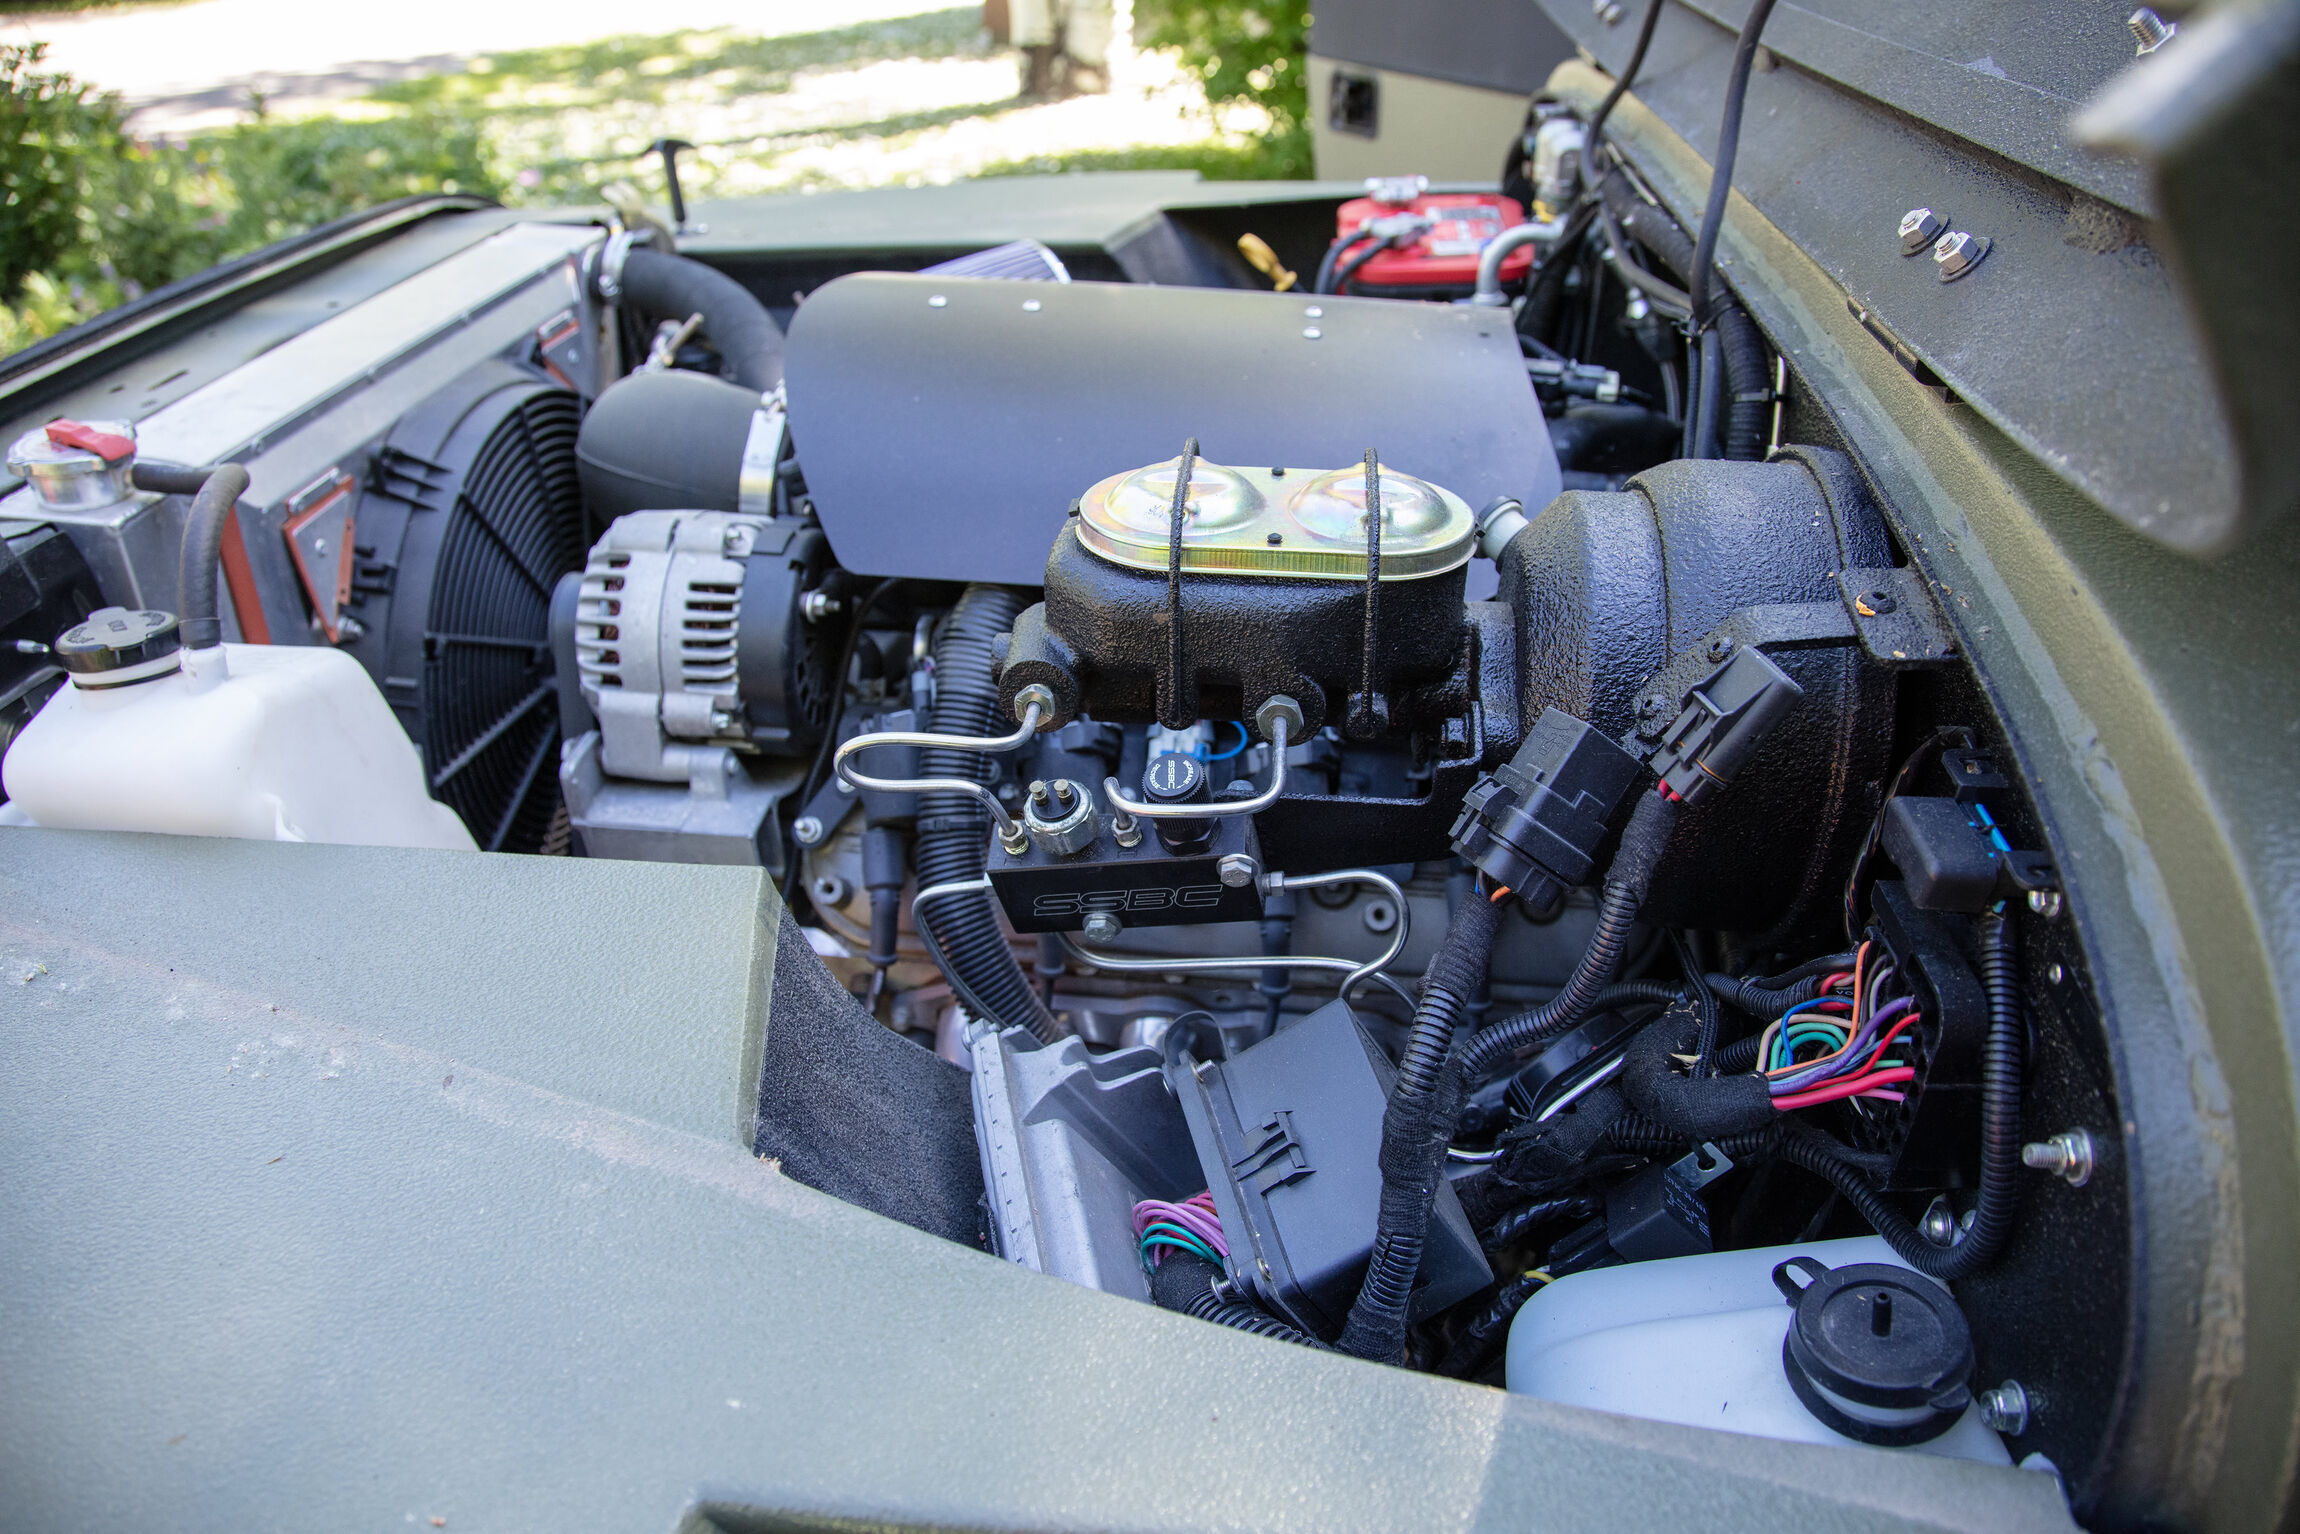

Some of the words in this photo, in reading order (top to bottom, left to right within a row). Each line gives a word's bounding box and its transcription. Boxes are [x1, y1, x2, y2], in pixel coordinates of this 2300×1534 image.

[1167, 759, 1176, 790] SSBC
[1182, 759, 1194, 785] INCREASE
[1033, 884, 1223, 916] SSBC
